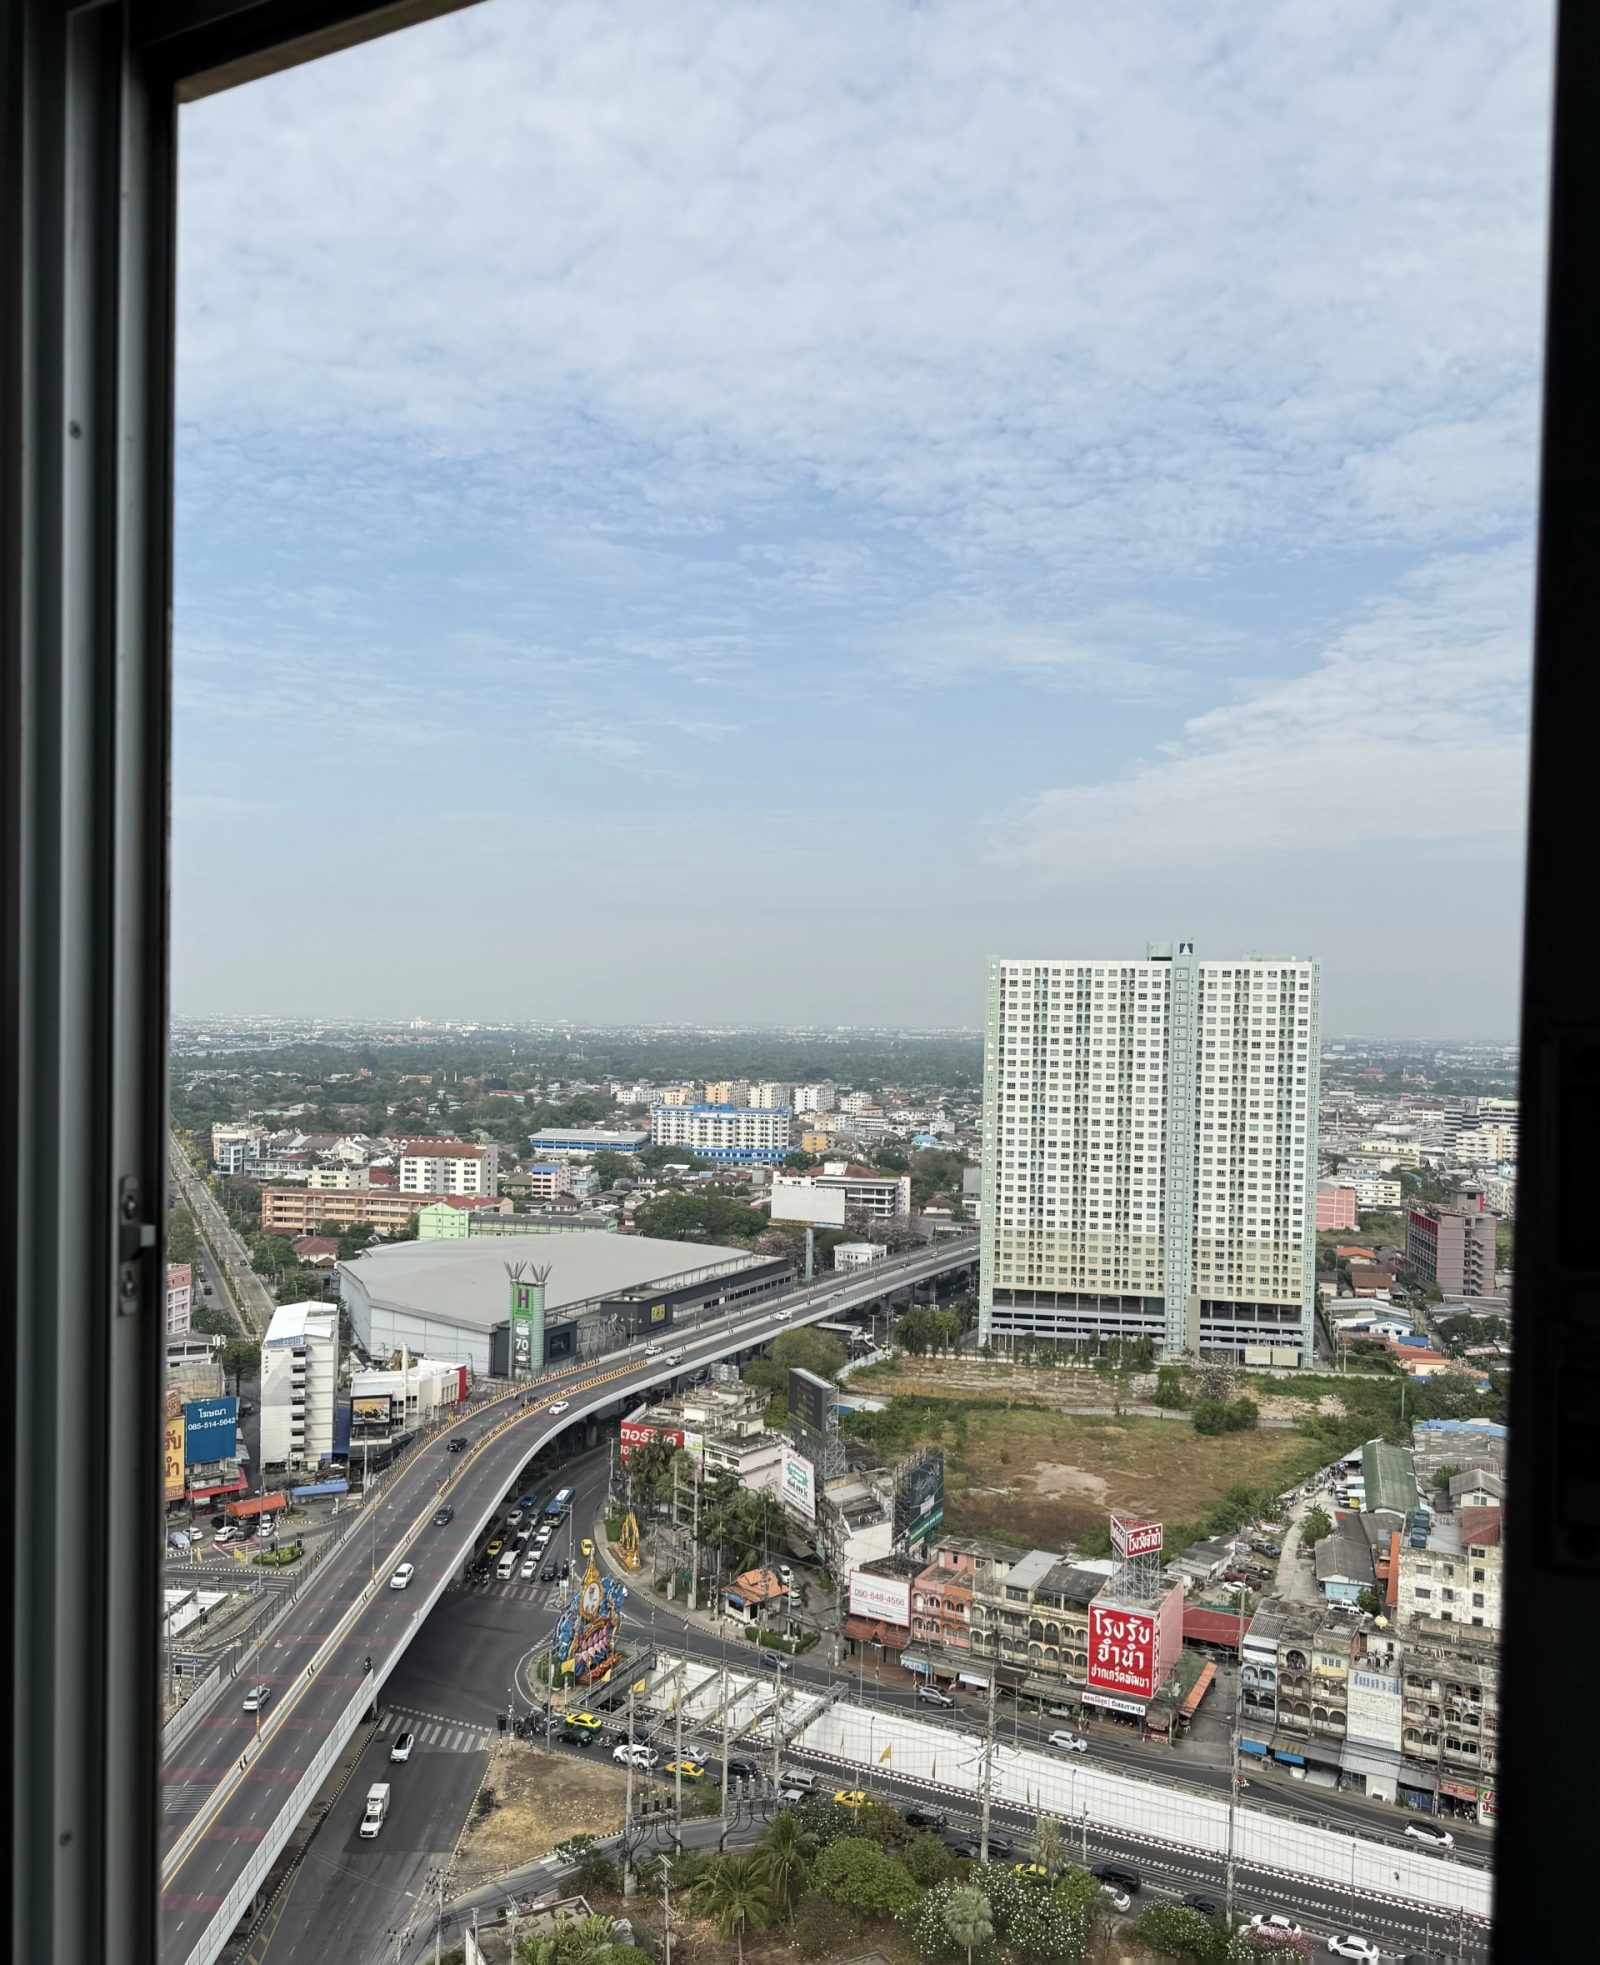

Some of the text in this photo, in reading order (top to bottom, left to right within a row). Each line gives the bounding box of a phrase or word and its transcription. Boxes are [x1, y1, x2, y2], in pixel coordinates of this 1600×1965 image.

[517, 1288, 529, 1308] H
[515, 1338, 528, 1351] 70
[198, 1407, 226, 1419] โฆษณา
[1128, 1528, 1161, 1552] โรงรับจำนำ
[1093, 1609, 1150, 1645] โรงรับ
[1097, 1639, 1145, 1670] จำนำ
[1091, 1663, 1150, 1689] ปากเกร็ดพัฒนา
